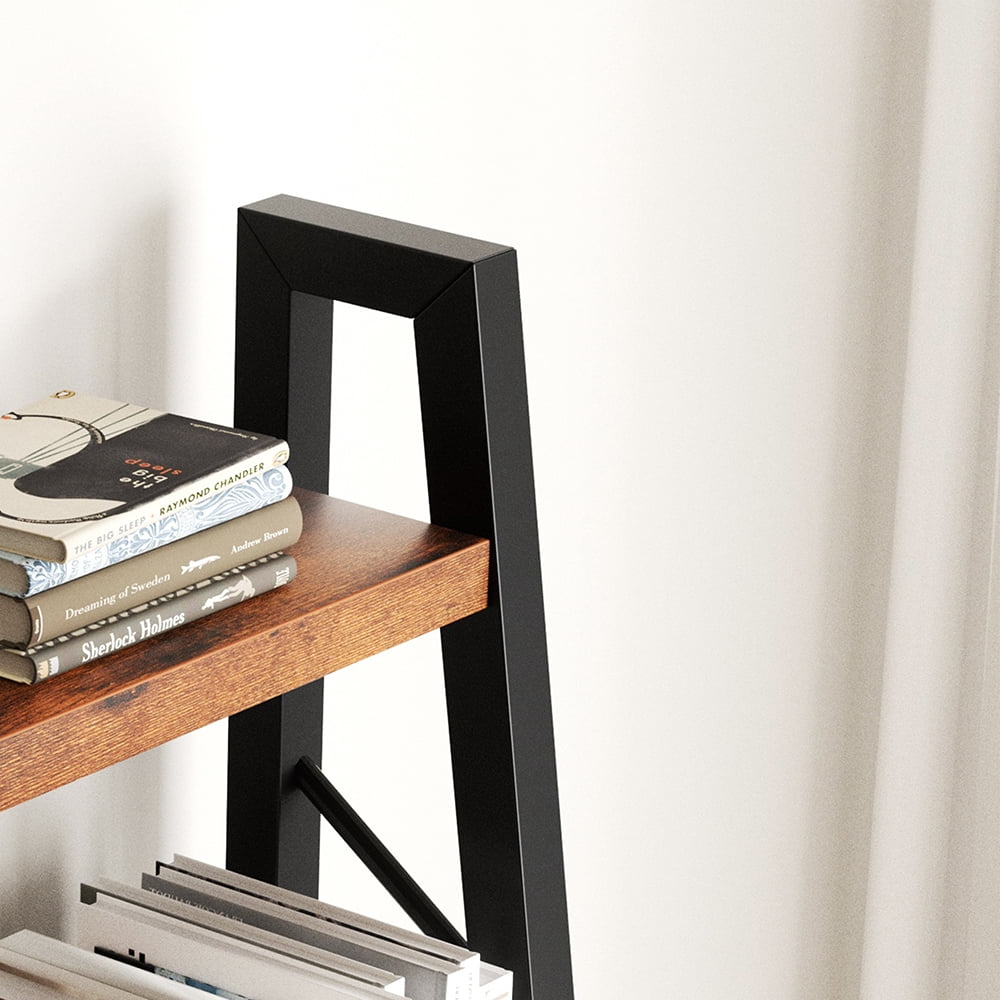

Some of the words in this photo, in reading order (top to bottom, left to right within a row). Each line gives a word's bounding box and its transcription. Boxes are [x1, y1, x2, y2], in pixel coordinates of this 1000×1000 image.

[125, 458, 182, 475] sleep
[132, 469, 168, 484] big
[74, 541, 93, 555] THE
[96, 531, 114, 545] BIG
[118, 516, 146, 535] SLEEP
[159, 487, 211, 516] RAYMOND
[213, 462, 265, 491] CHANDLER
[65, 593, 117, 620] Dreaming
[118, 586, 130, 598] of
[130, 574, 171, 593] Sweden
[230, 538, 262, 555] Andrew
[263, 526, 289, 542] Brown
[81, 626, 137, 663] Sherlock
[140, 612, 185, 641] Holmes
